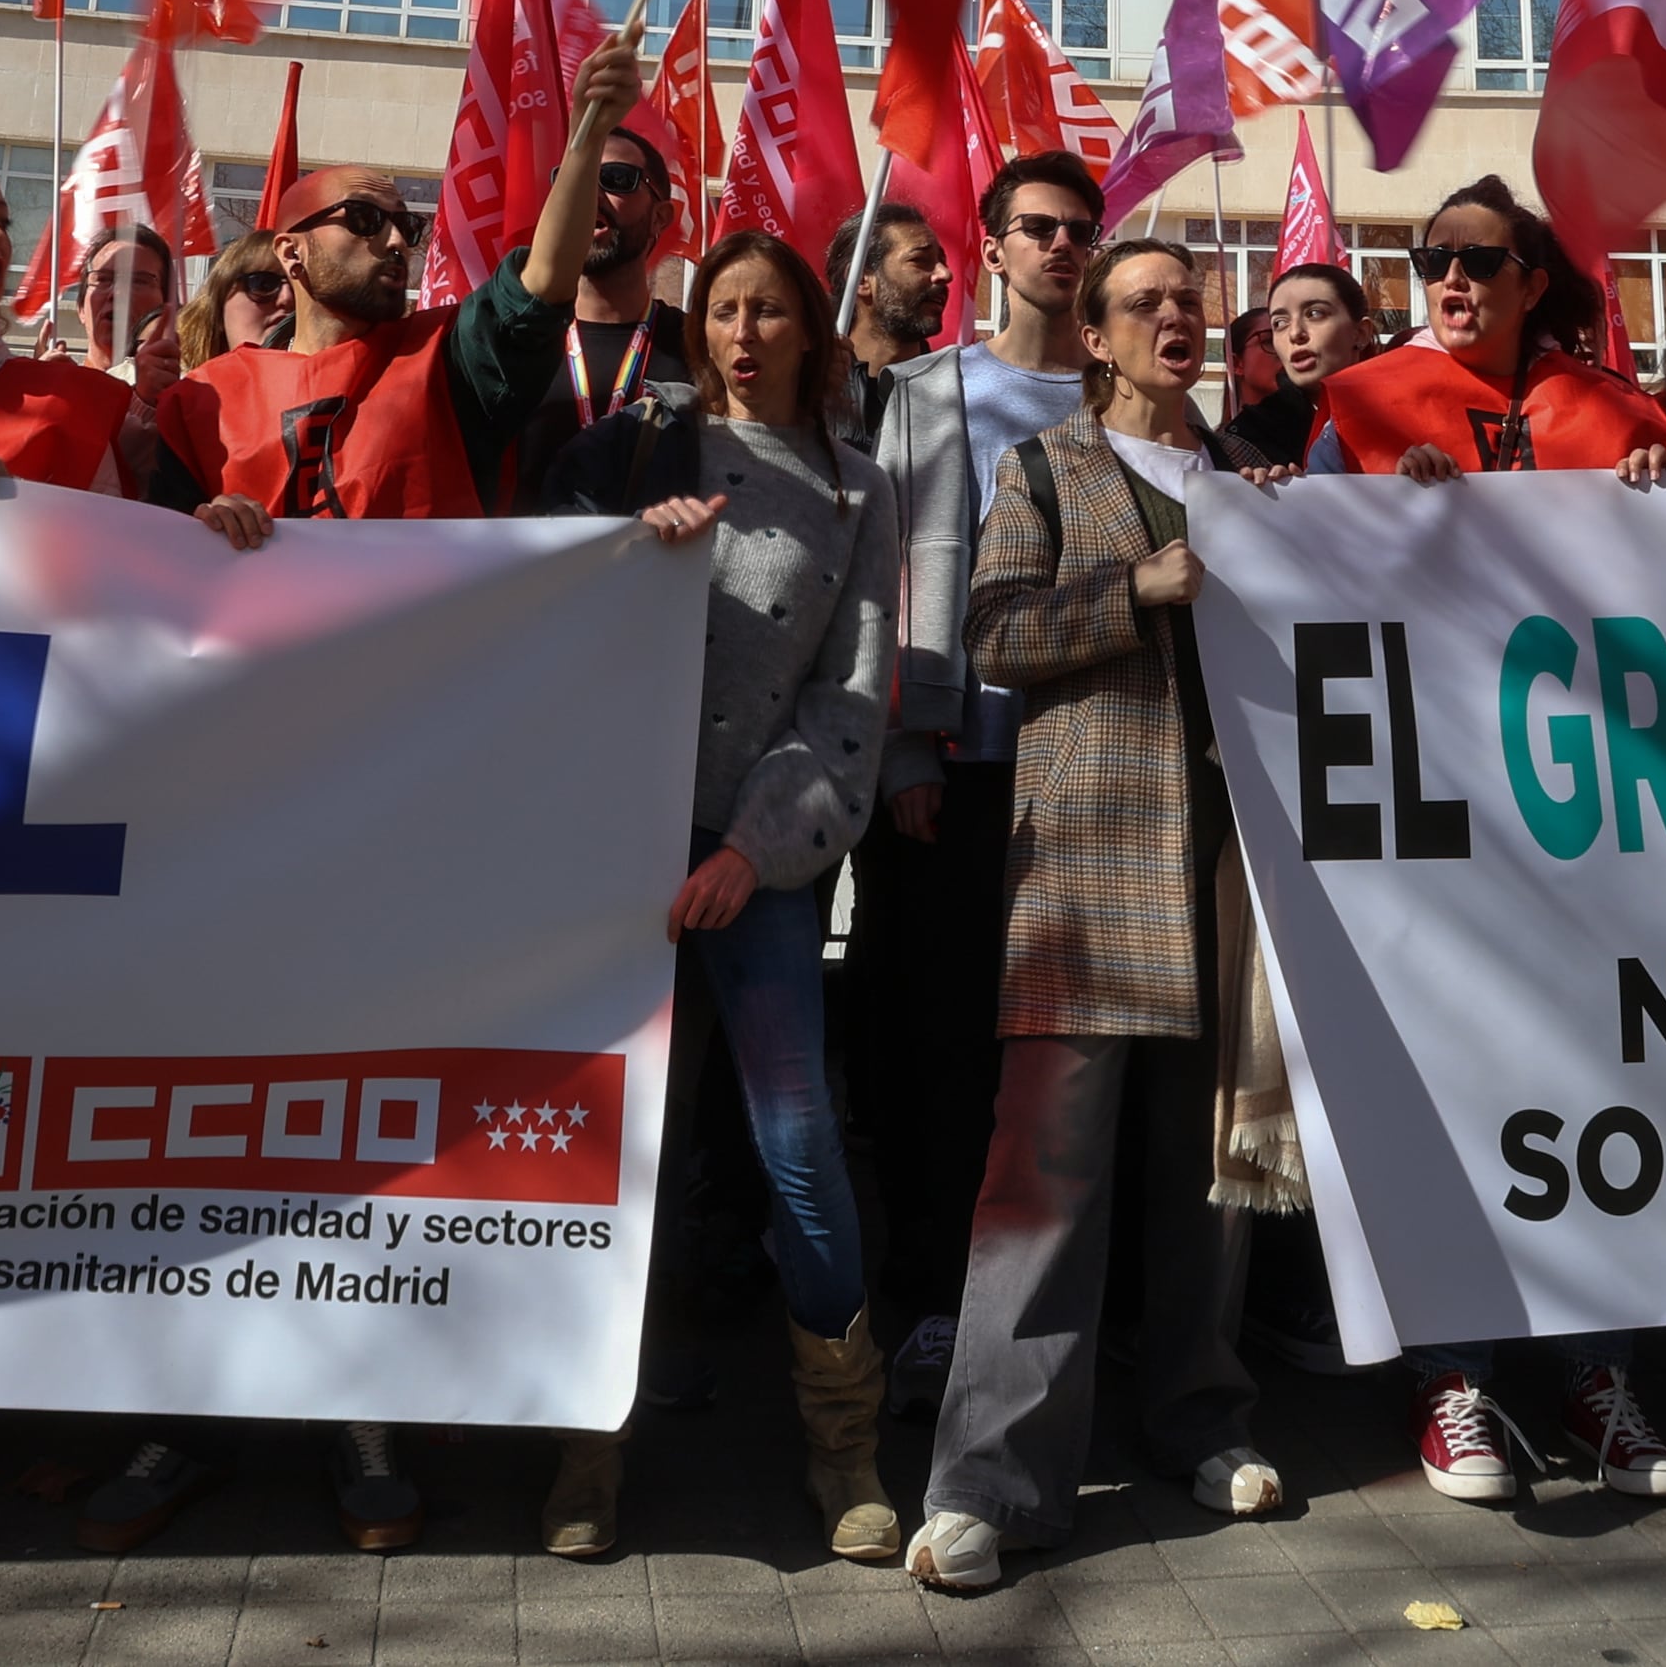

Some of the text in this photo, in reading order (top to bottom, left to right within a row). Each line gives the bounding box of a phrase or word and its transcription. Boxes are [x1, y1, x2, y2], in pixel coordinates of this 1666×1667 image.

[1293, 621, 1472, 862] EL
[67, 1078, 442, 1165] CCOO
[131, 1194, 186, 1233] de
[198, 1198, 374, 1241] sanidad
[384, 1211, 411, 1251] y
[422, 1209, 613, 1251] sectores
[225, 1259, 282, 1300] de
[294, 1260, 451, 1307] Madrid
